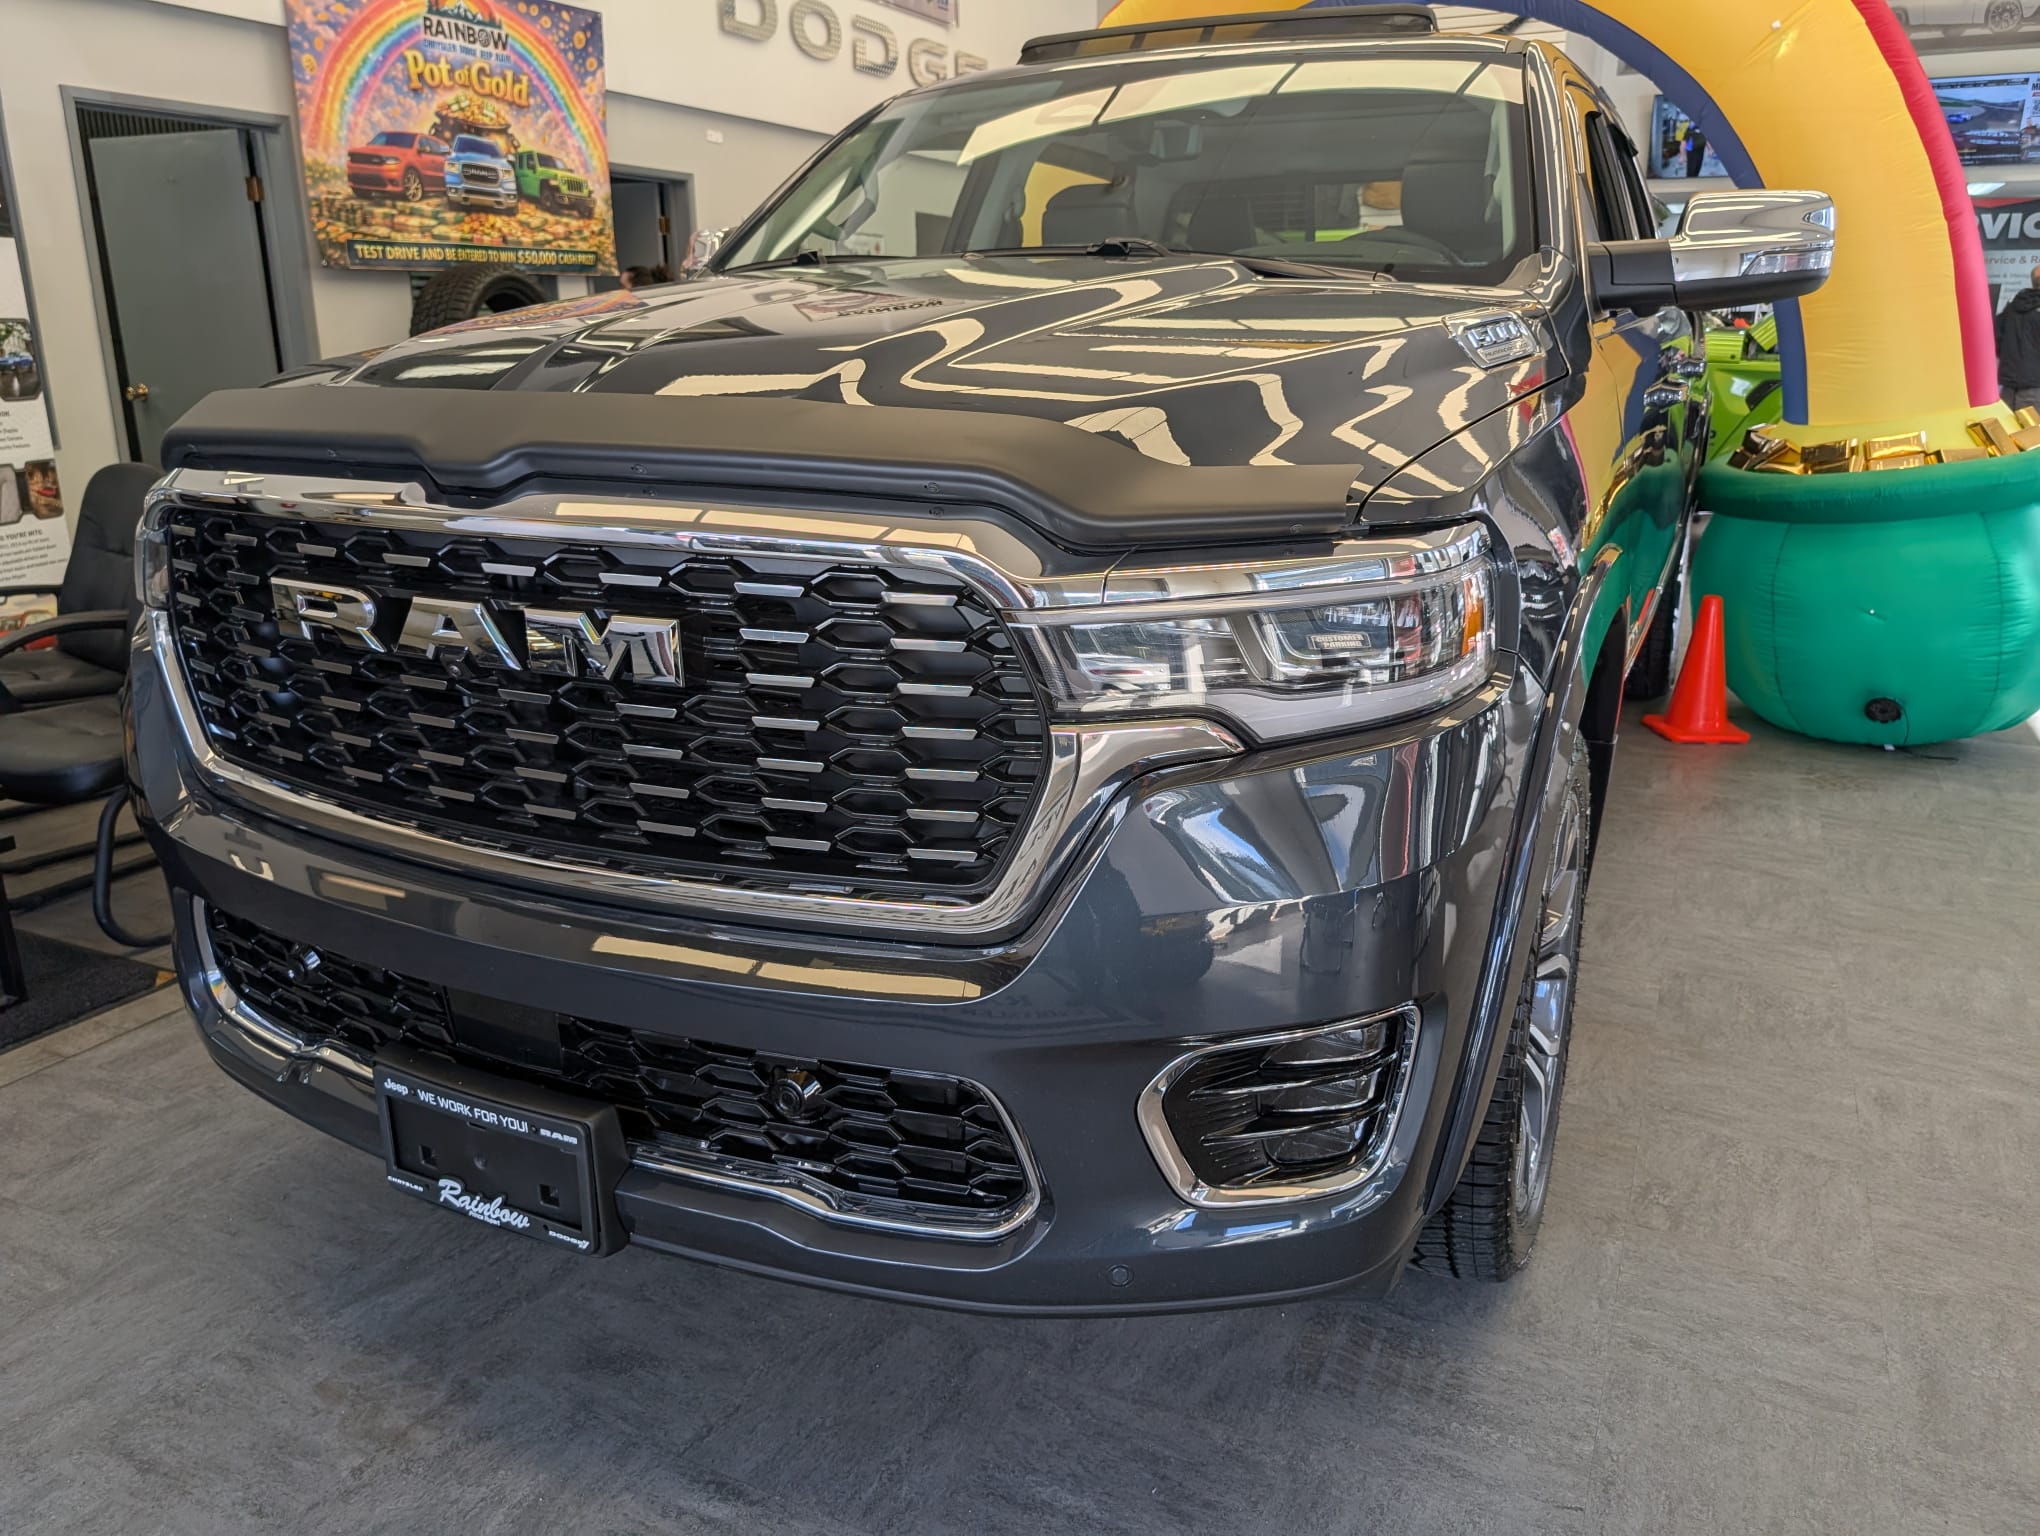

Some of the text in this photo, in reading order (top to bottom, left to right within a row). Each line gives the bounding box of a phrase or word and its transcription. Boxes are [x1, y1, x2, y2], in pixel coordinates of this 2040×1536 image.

[423, 16, 510, 51] RAINBOW
[404, 48, 529, 108] Pot of Gold
[1976, 211, 2040, 239] VIC
[354, 244, 383, 259] TEST
[385, 246, 420, 260] DRIVE
[421, 246, 444, 260] AND
[488, 250, 500, 262] TO
[500, 250, 516, 263] WIN
[517, 250, 557, 266] $50,000
[271, 577, 686, 688] RAM
[384, 1078, 409, 1096] Jeep
[417, 1088, 437, 1105] WE
[437, 1095, 472, 1117] WORK
[474, 1107, 498, 1125] FOR
[540, 1128, 578, 1145] RAM
[438, 1178, 530, 1229] Rainbow
